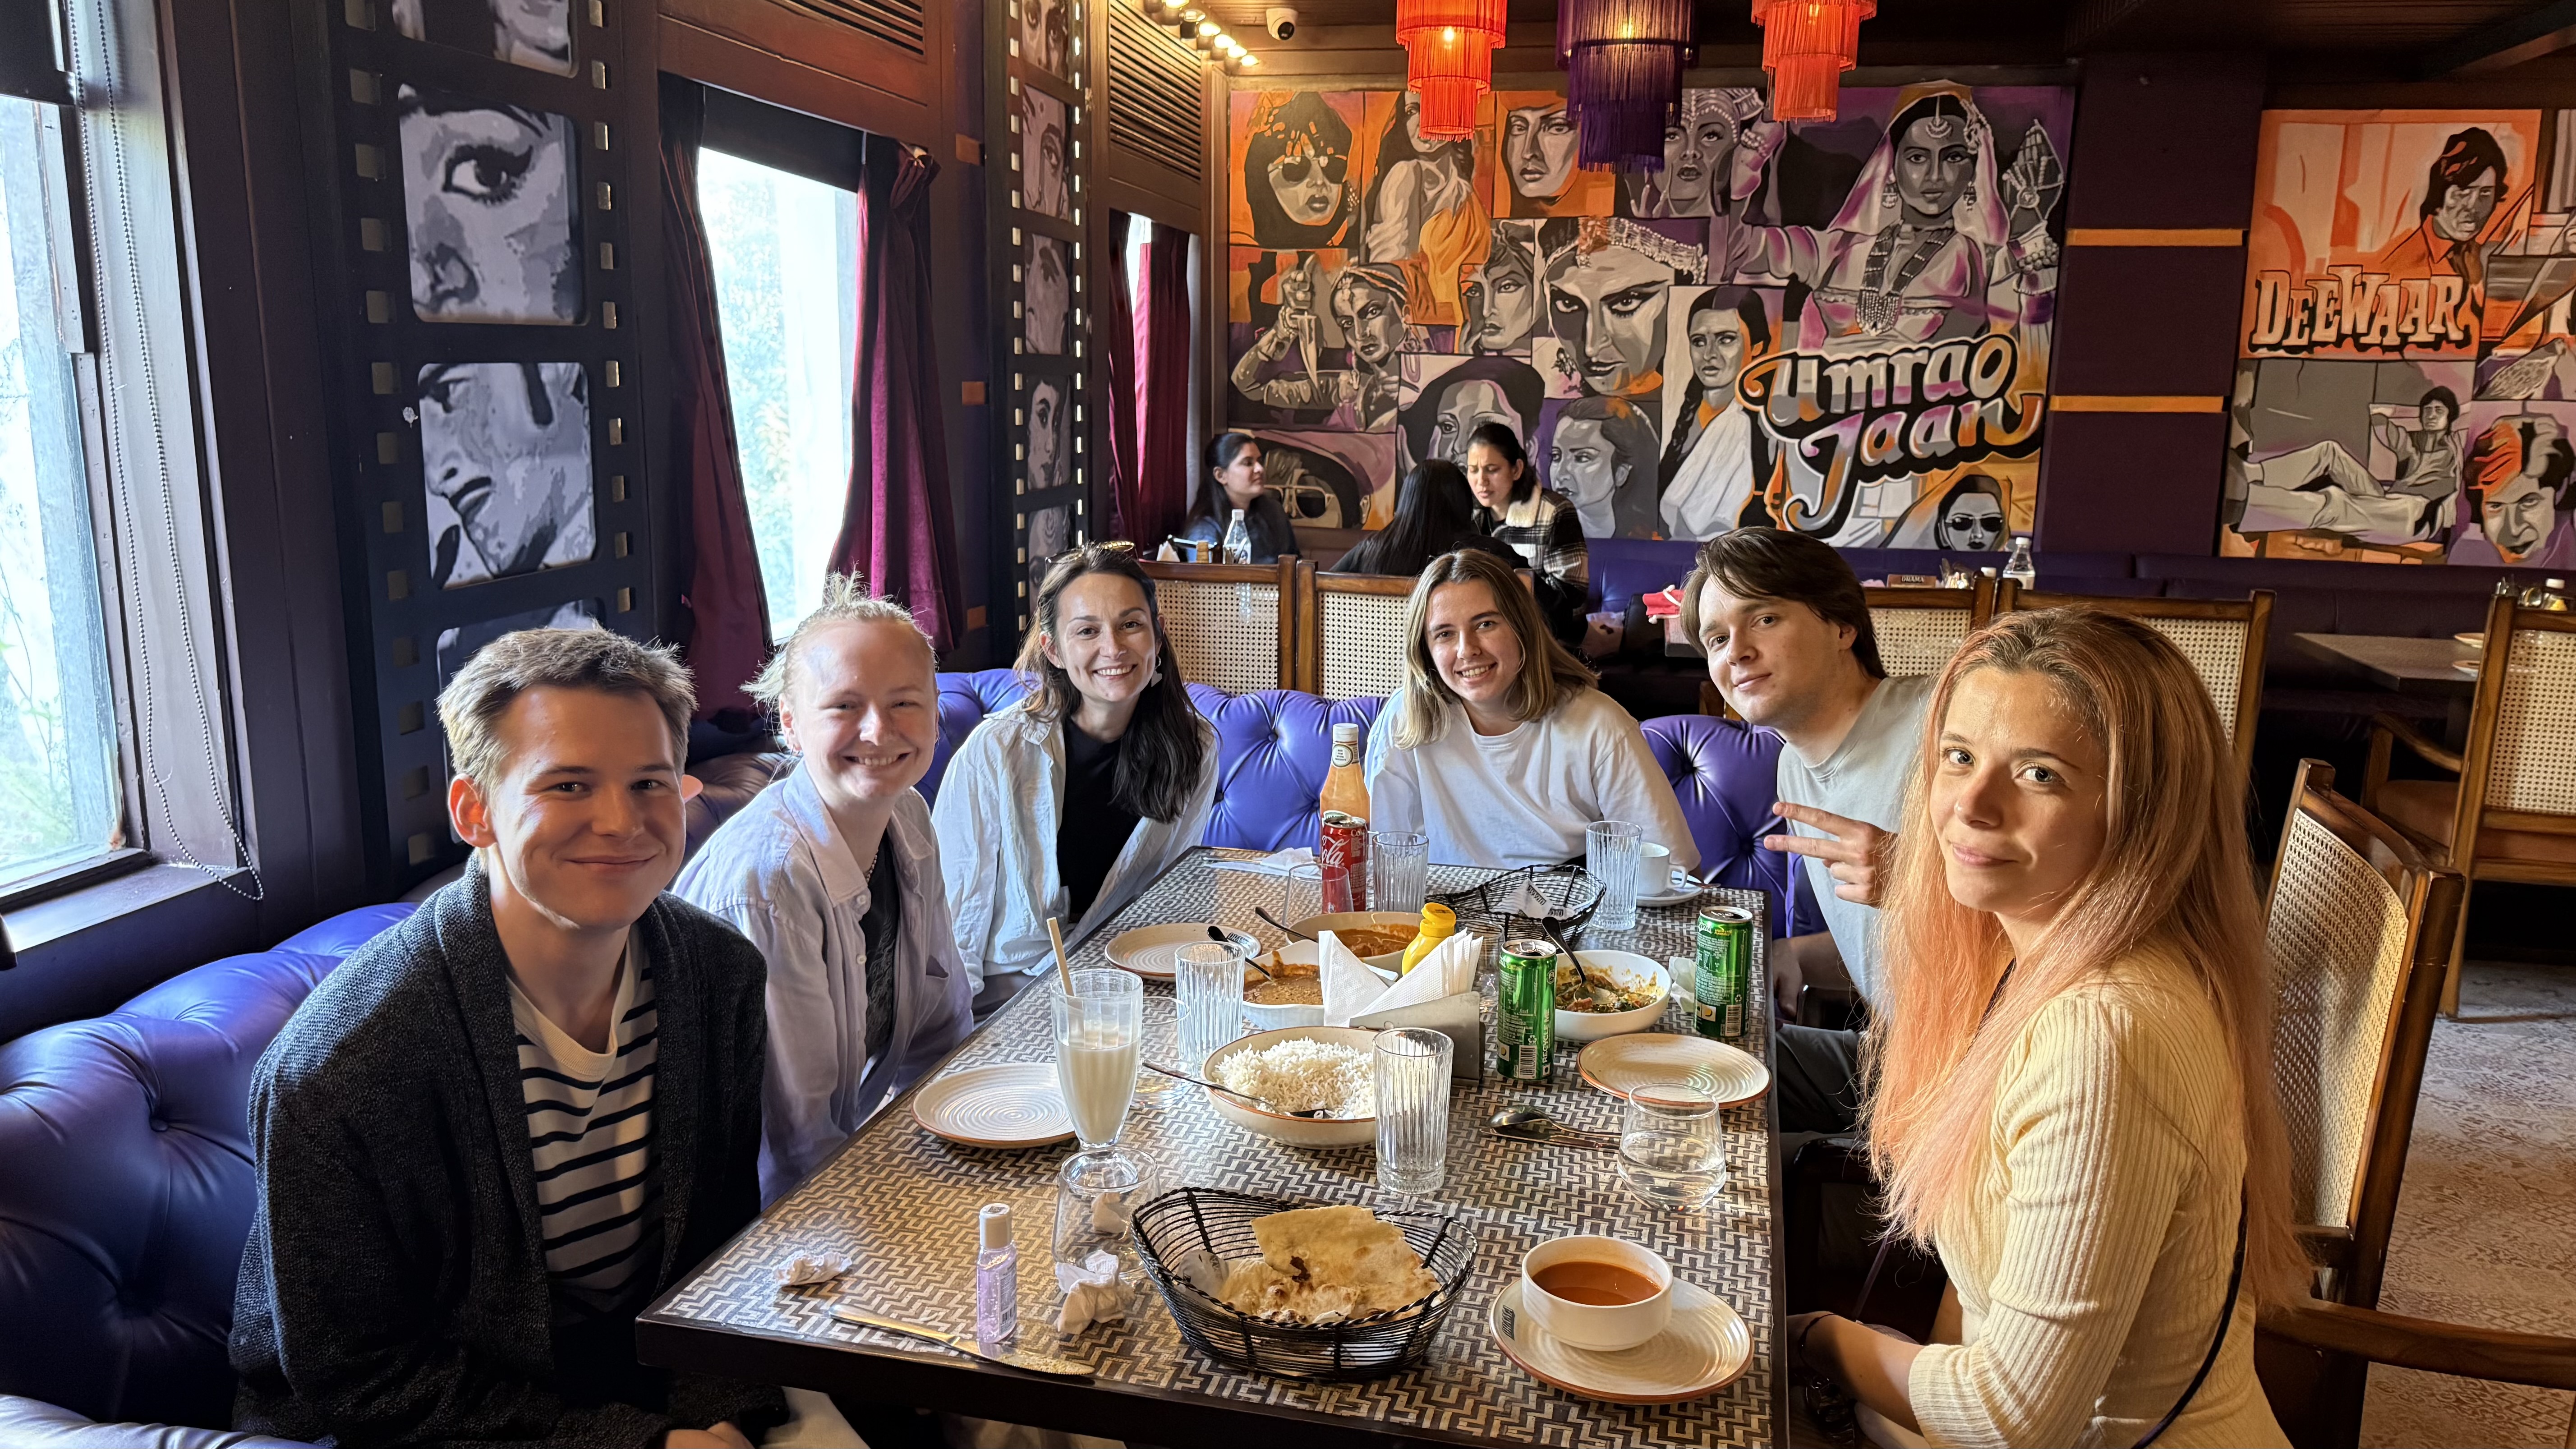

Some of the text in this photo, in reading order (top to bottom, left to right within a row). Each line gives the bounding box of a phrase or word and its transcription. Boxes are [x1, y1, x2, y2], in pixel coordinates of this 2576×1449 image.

[2250, 265, 2465, 347] DEEWAAR
[1322, 835, 1350, 866] ola
[1227, 932, 1249, 945] DRA
[1544, 1008, 1550, 1022] ME
